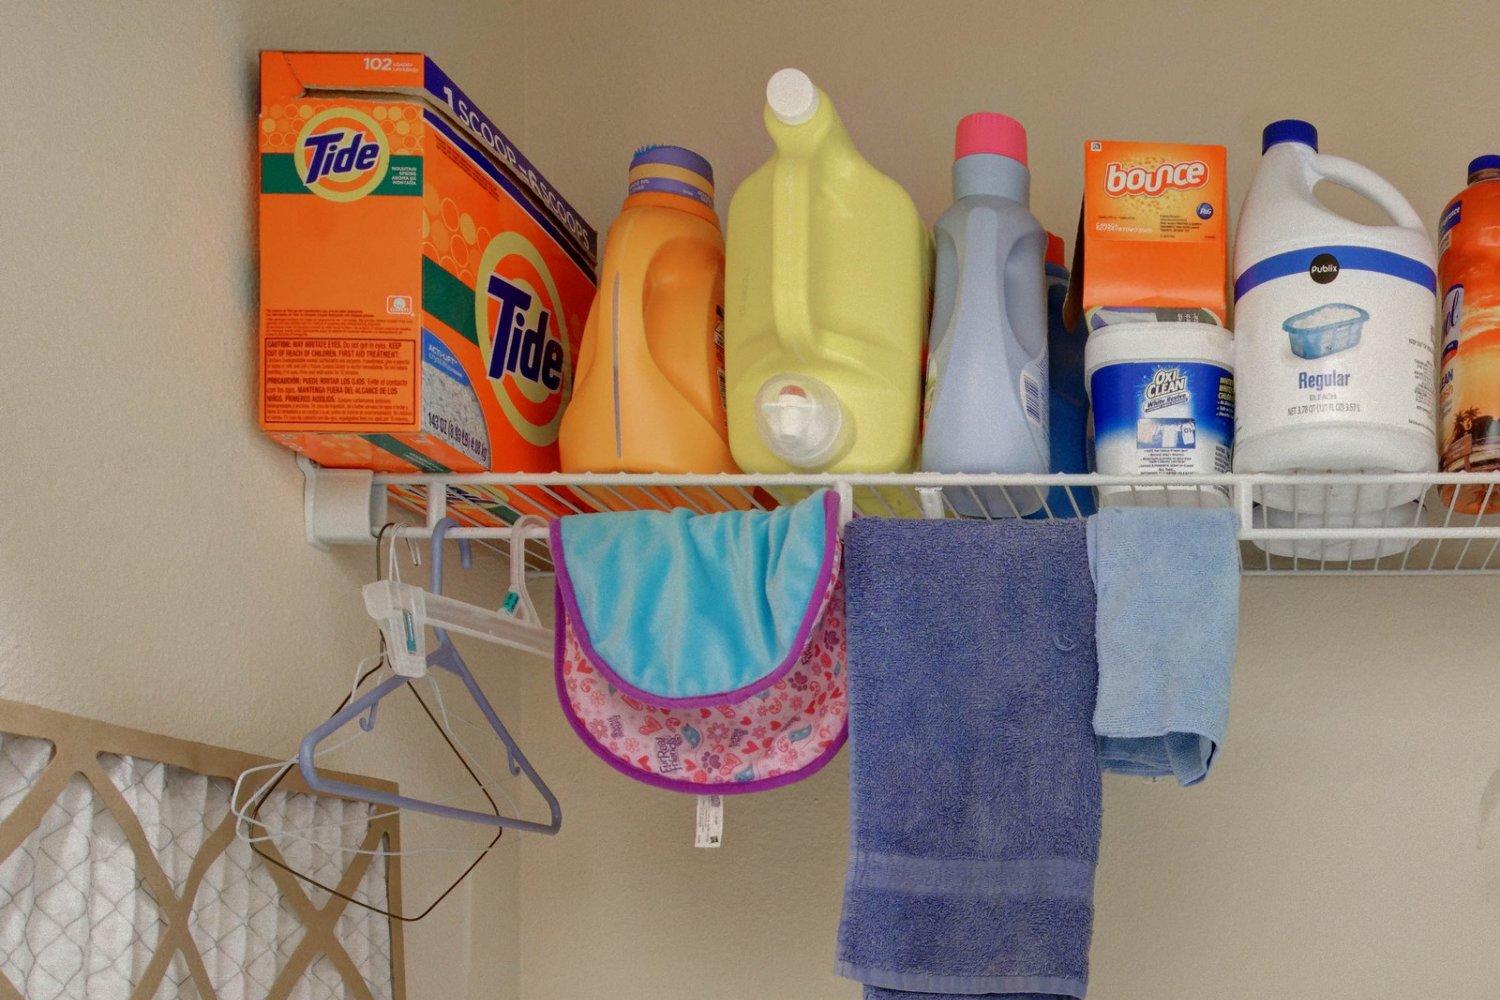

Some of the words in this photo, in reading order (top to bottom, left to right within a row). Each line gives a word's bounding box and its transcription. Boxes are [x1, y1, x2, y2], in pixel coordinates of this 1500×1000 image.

[364, 58, 392, 71] 102
[458, 100, 517, 166] SCOOP
[304, 131, 380, 185] Tide
[1106, 162, 1205, 193] bounce
[1311, 264, 1337, 274] publix
[487, 274, 564, 391] Tide
[1147, 378, 1186, 399] CLEAN
[1155, 370, 1177, 386] OXI
[1299, 370, 1350, 391] Regular
